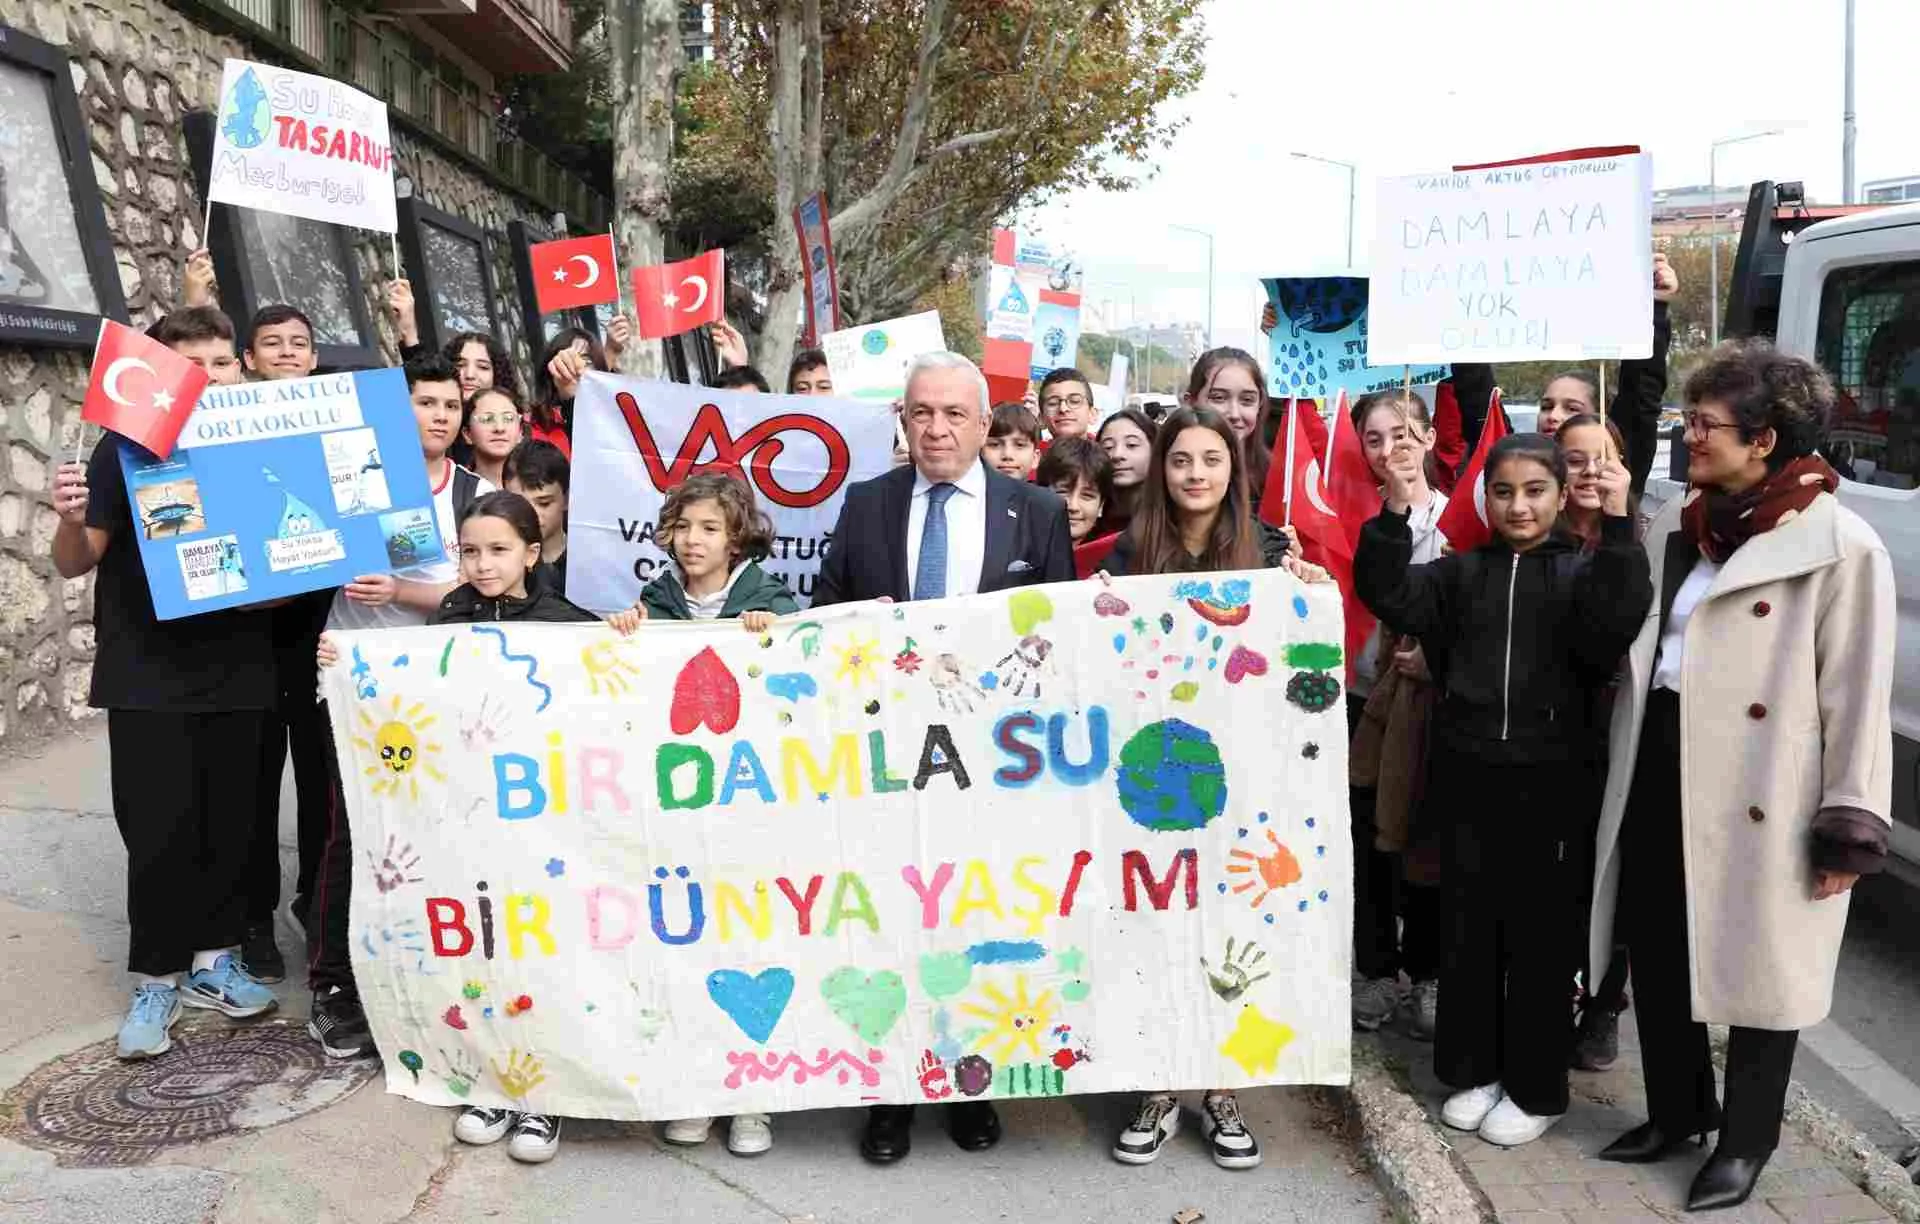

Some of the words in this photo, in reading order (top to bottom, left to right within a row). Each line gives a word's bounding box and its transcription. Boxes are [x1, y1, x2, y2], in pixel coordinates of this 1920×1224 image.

[272, 74, 319, 114] Su
[1401, 201, 1607, 249] DAMLAYA
[1401, 251, 1596, 297] DAMLAYA
[1458, 291, 1518, 319] YOK
[1441, 317, 1549, 351] OLUR!
[195, 385, 267, 411] AHİDE
[274, 375, 351, 403] AKTUĞ
[197, 407, 342, 440] ORTAOKULU
[615, 391, 850, 508] VAO
[492, 730, 632, 820] BİR
[655, 724, 971, 811] DAMLA
[993, 705, 1110, 789] SU
[426, 880, 558, 960] BİR
[585, 865, 880, 951] DÜNYA
